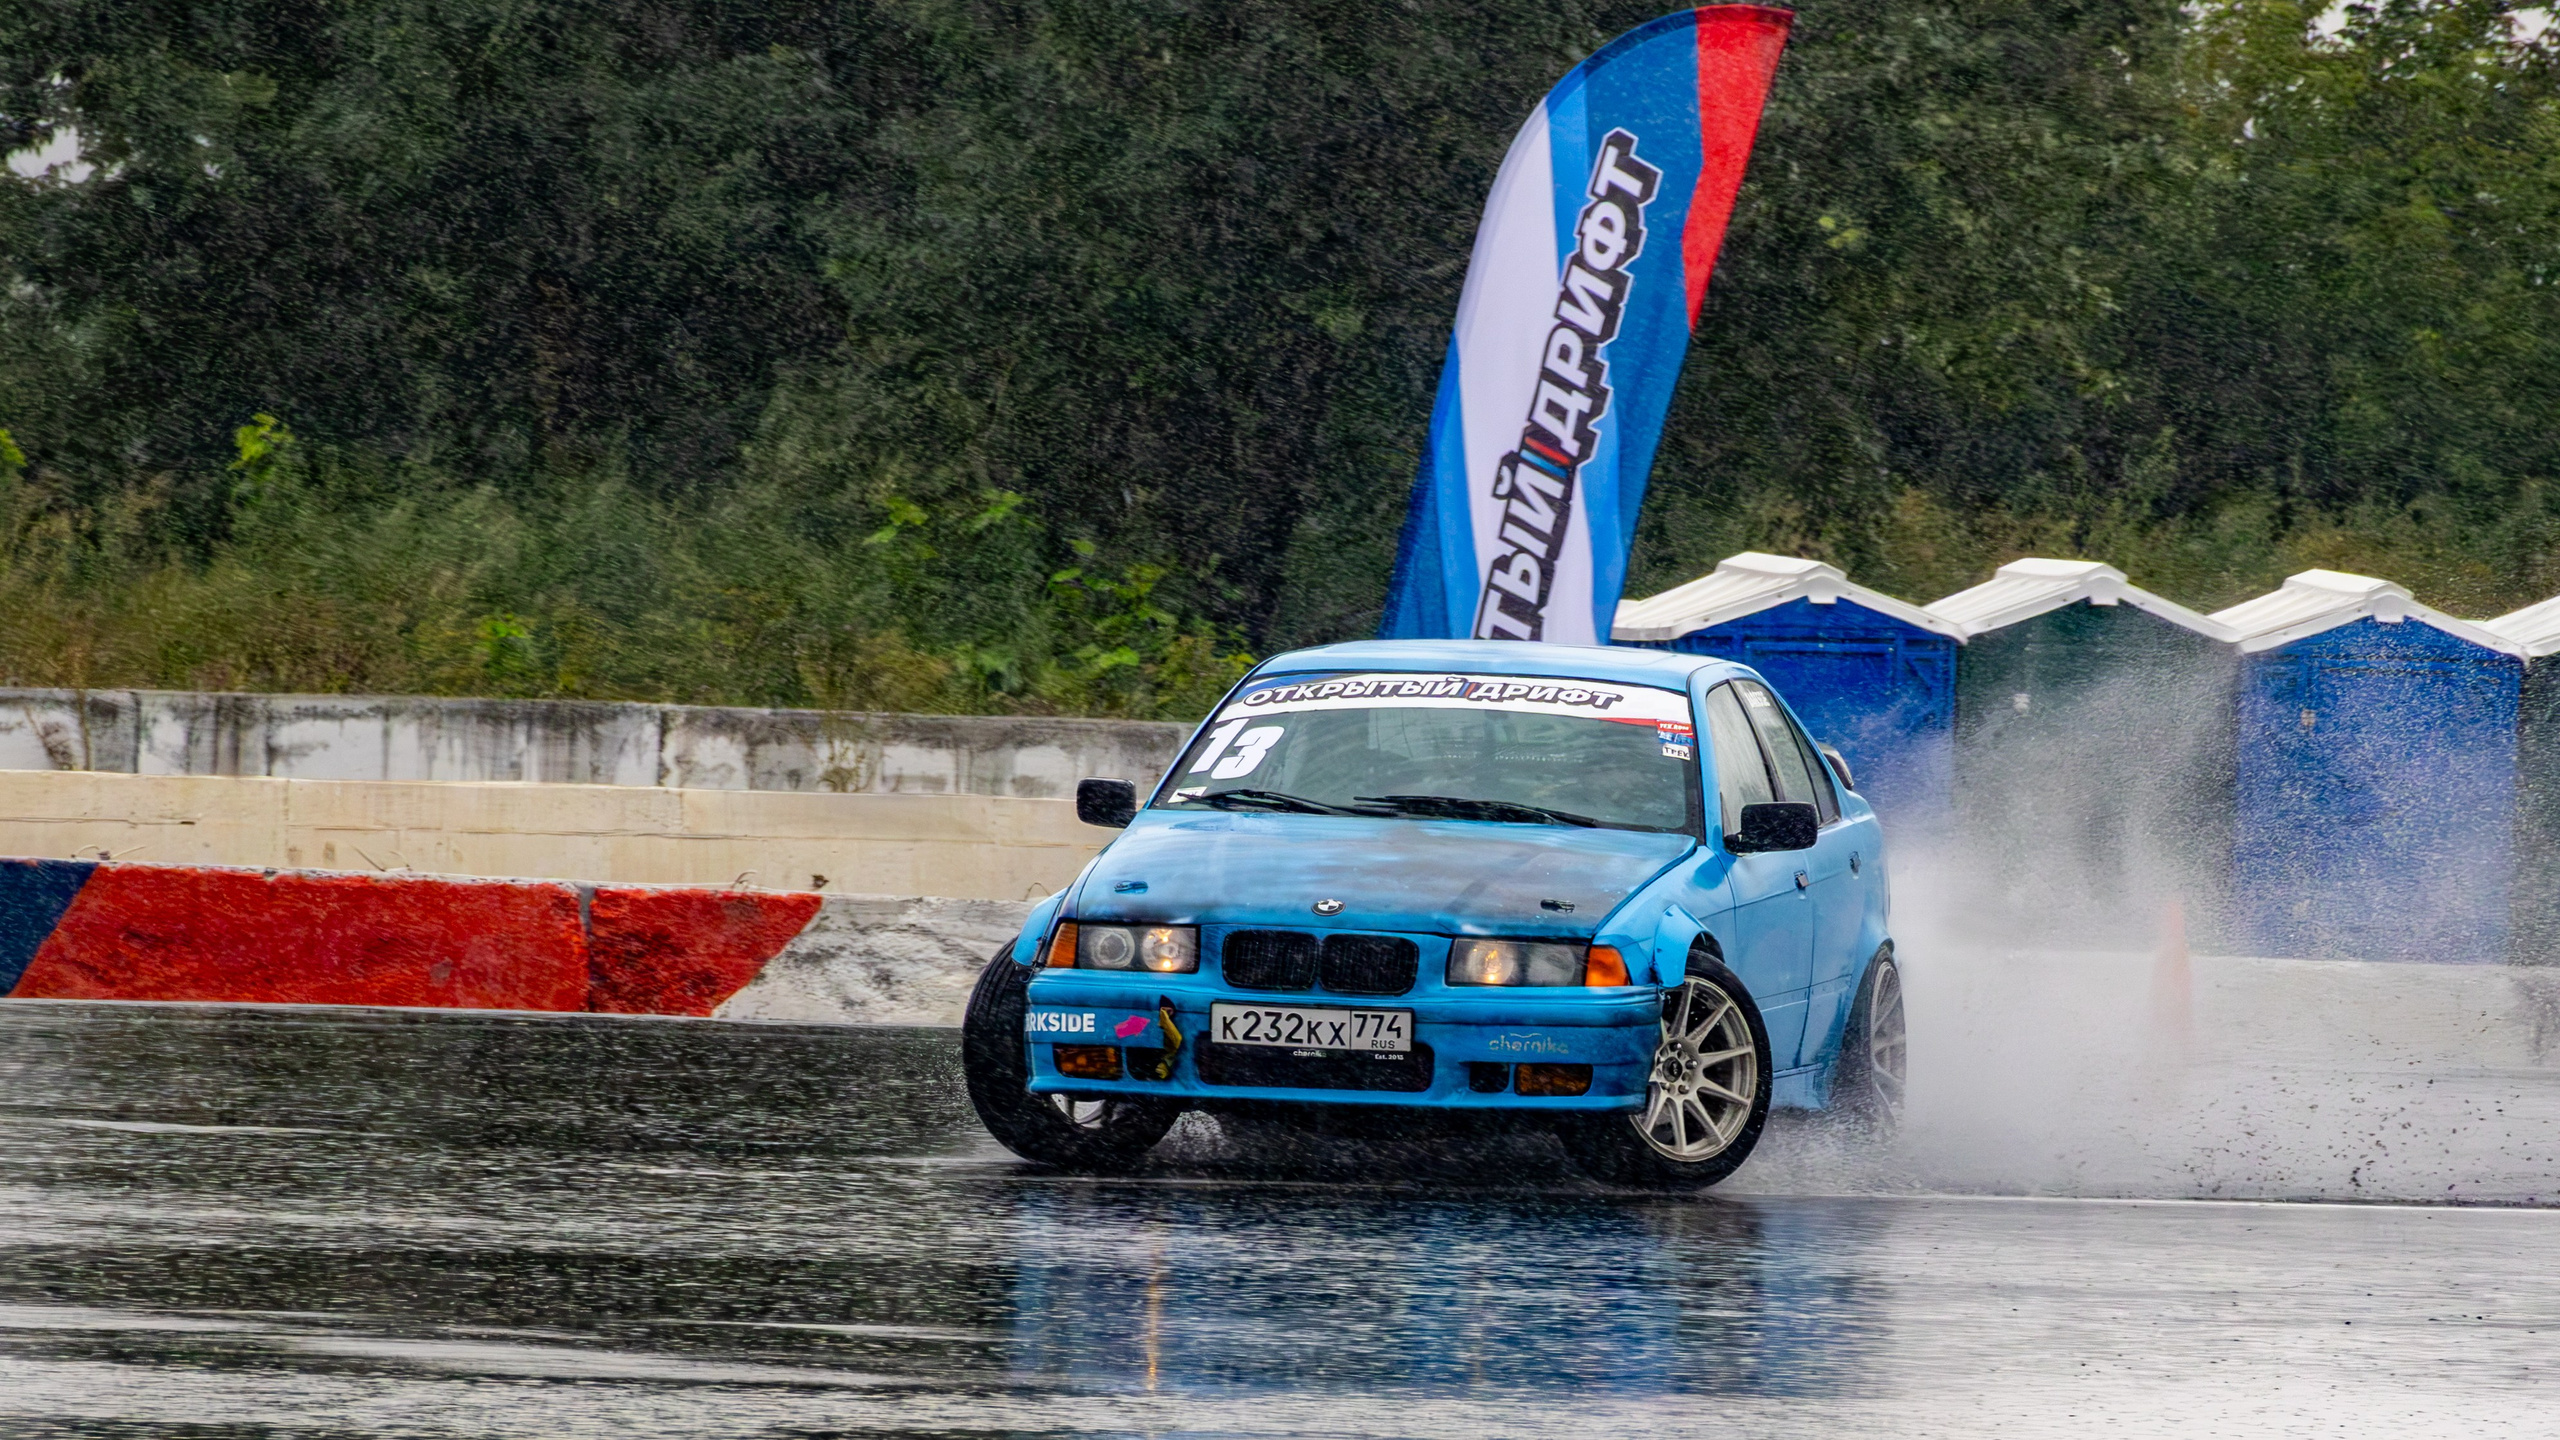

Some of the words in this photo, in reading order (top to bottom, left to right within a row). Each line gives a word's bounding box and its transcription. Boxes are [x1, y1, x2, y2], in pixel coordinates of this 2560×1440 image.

[1476, 454, 1570, 641] ТЫЙ
[1528, 129, 1660, 462] ДРИФТ
[1243, 676, 1463, 707] ОТКРЫТЫЙ
[1468, 682, 1624, 710] ДРИФТ
[1188, 718, 1285, 780] 13
[1353, 1012, 1402, 1039] 774
[1371, 1039, 1396, 1049] RUS
[1488, 1034, 1569, 1054] chernika
